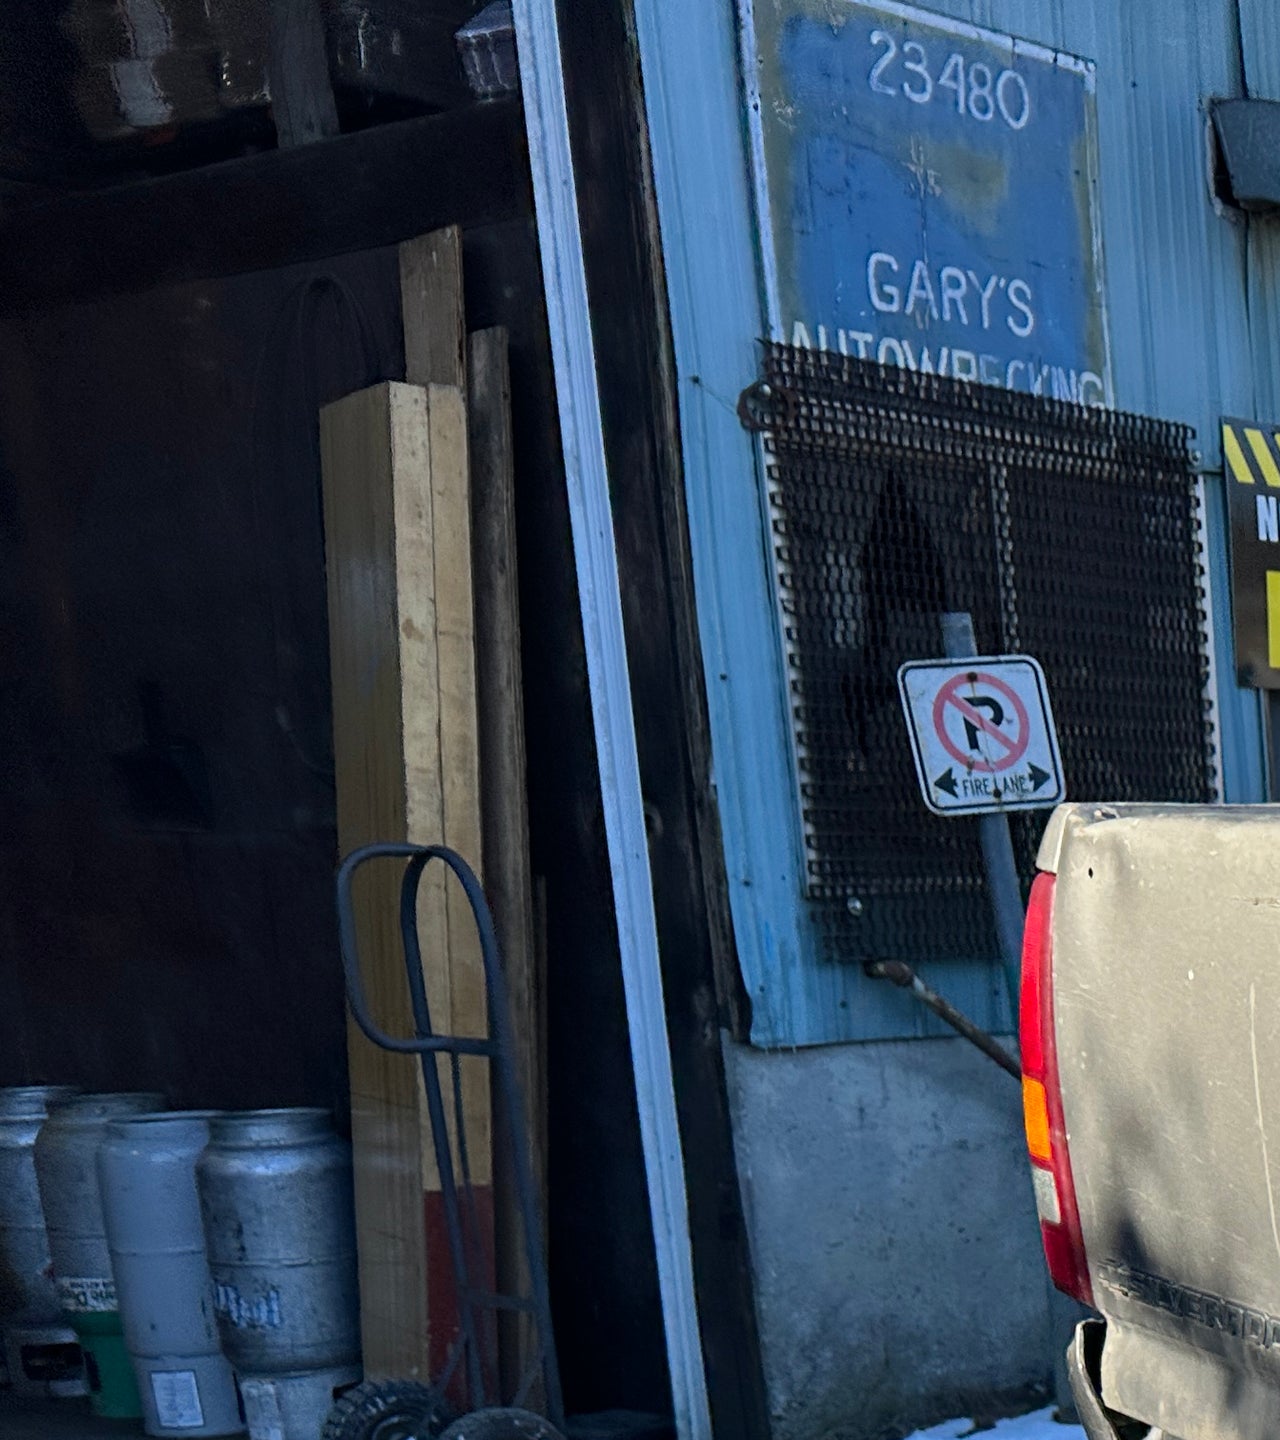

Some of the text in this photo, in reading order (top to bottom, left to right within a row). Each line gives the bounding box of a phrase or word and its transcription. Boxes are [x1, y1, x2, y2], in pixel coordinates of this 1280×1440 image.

[869, 29, 1031, 130] 23480
[867, 251, 1035, 338] GARY'S
[961, 774, 1031, 797] FIRE LANE
